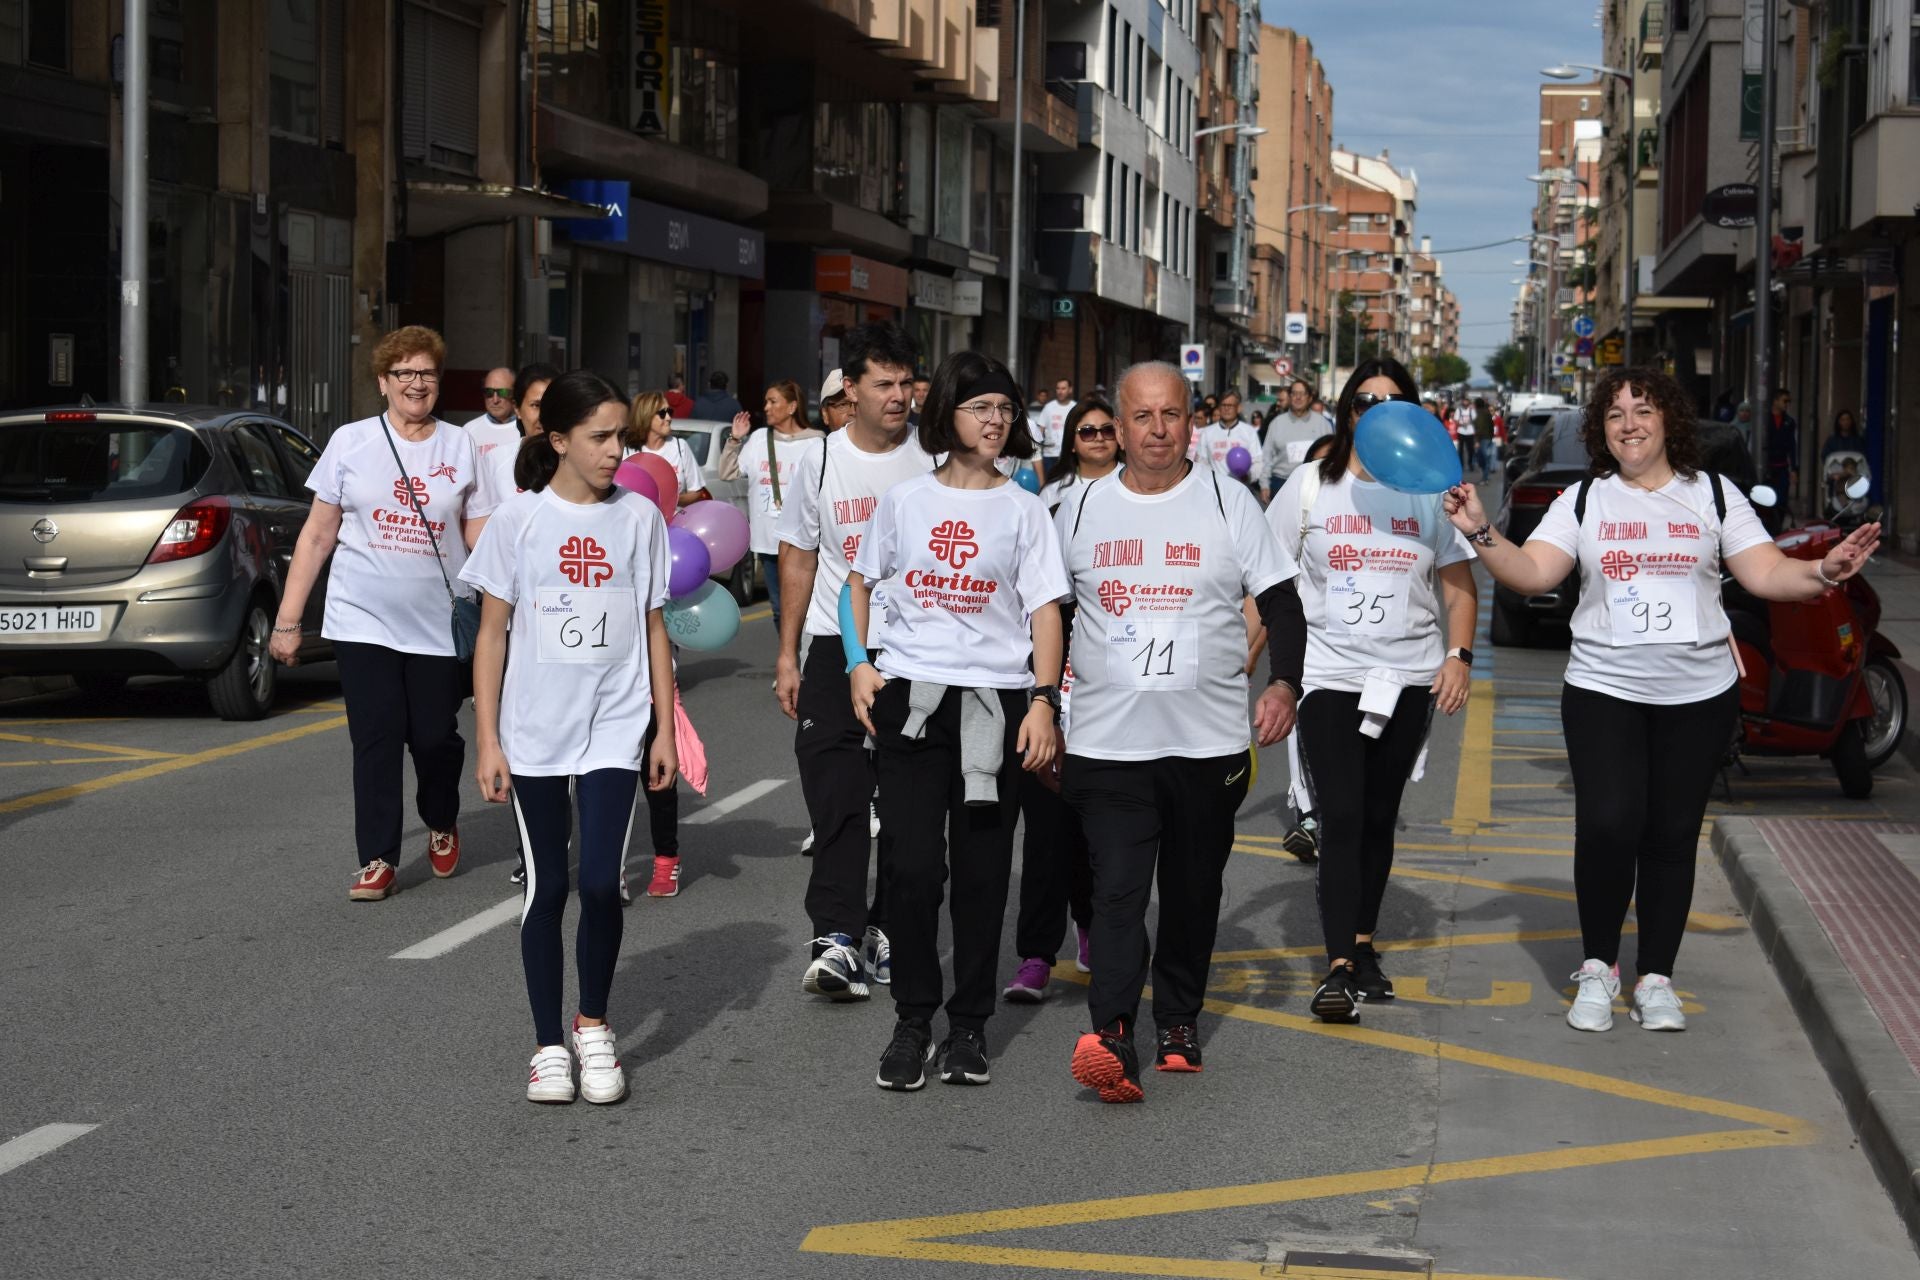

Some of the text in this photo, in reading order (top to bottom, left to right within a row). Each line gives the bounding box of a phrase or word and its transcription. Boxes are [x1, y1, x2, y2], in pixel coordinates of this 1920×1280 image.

[668, 220, 689, 250] BBVA
[738, 238, 757, 265] BBVA
[378, 523, 441, 540] Interparroqal
[1328, 514, 1372, 534] SOLIDARIA
[1391, 517, 1419, 532] berlin
[1602, 521, 1648, 541] SOLIDARIA
[1668, 522, 1699, 534] berlin
[367, 541, 392, 551] Carrera
[394, 545, 422, 554] Popular
[383, 532, 433, 546] de Calahorr
[1096, 539, 1143, 568] SOLIDARIA
[1166, 542, 1200, 561] berlin
[1360, 548, 1418, 560] Cáritas
[1636, 553, 1698, 563] Cáritas
[905, 569, 997, 593] Cáritas
[1130, 584, 1193, 596] Cáritas
[914, 589, 990, 604] Interparroquial
[542, 605, 573, 613] Calahorra
[922, 599, 982, 614] de Calahorra
[1342, 591, 1394, 625] 35
[0, 611, 95, 630] 5021 HHD
[1632, 602, 1672, 633] 93
[560, 612, 609, 648] 61
[1131, 637, 1175, 677] 11
